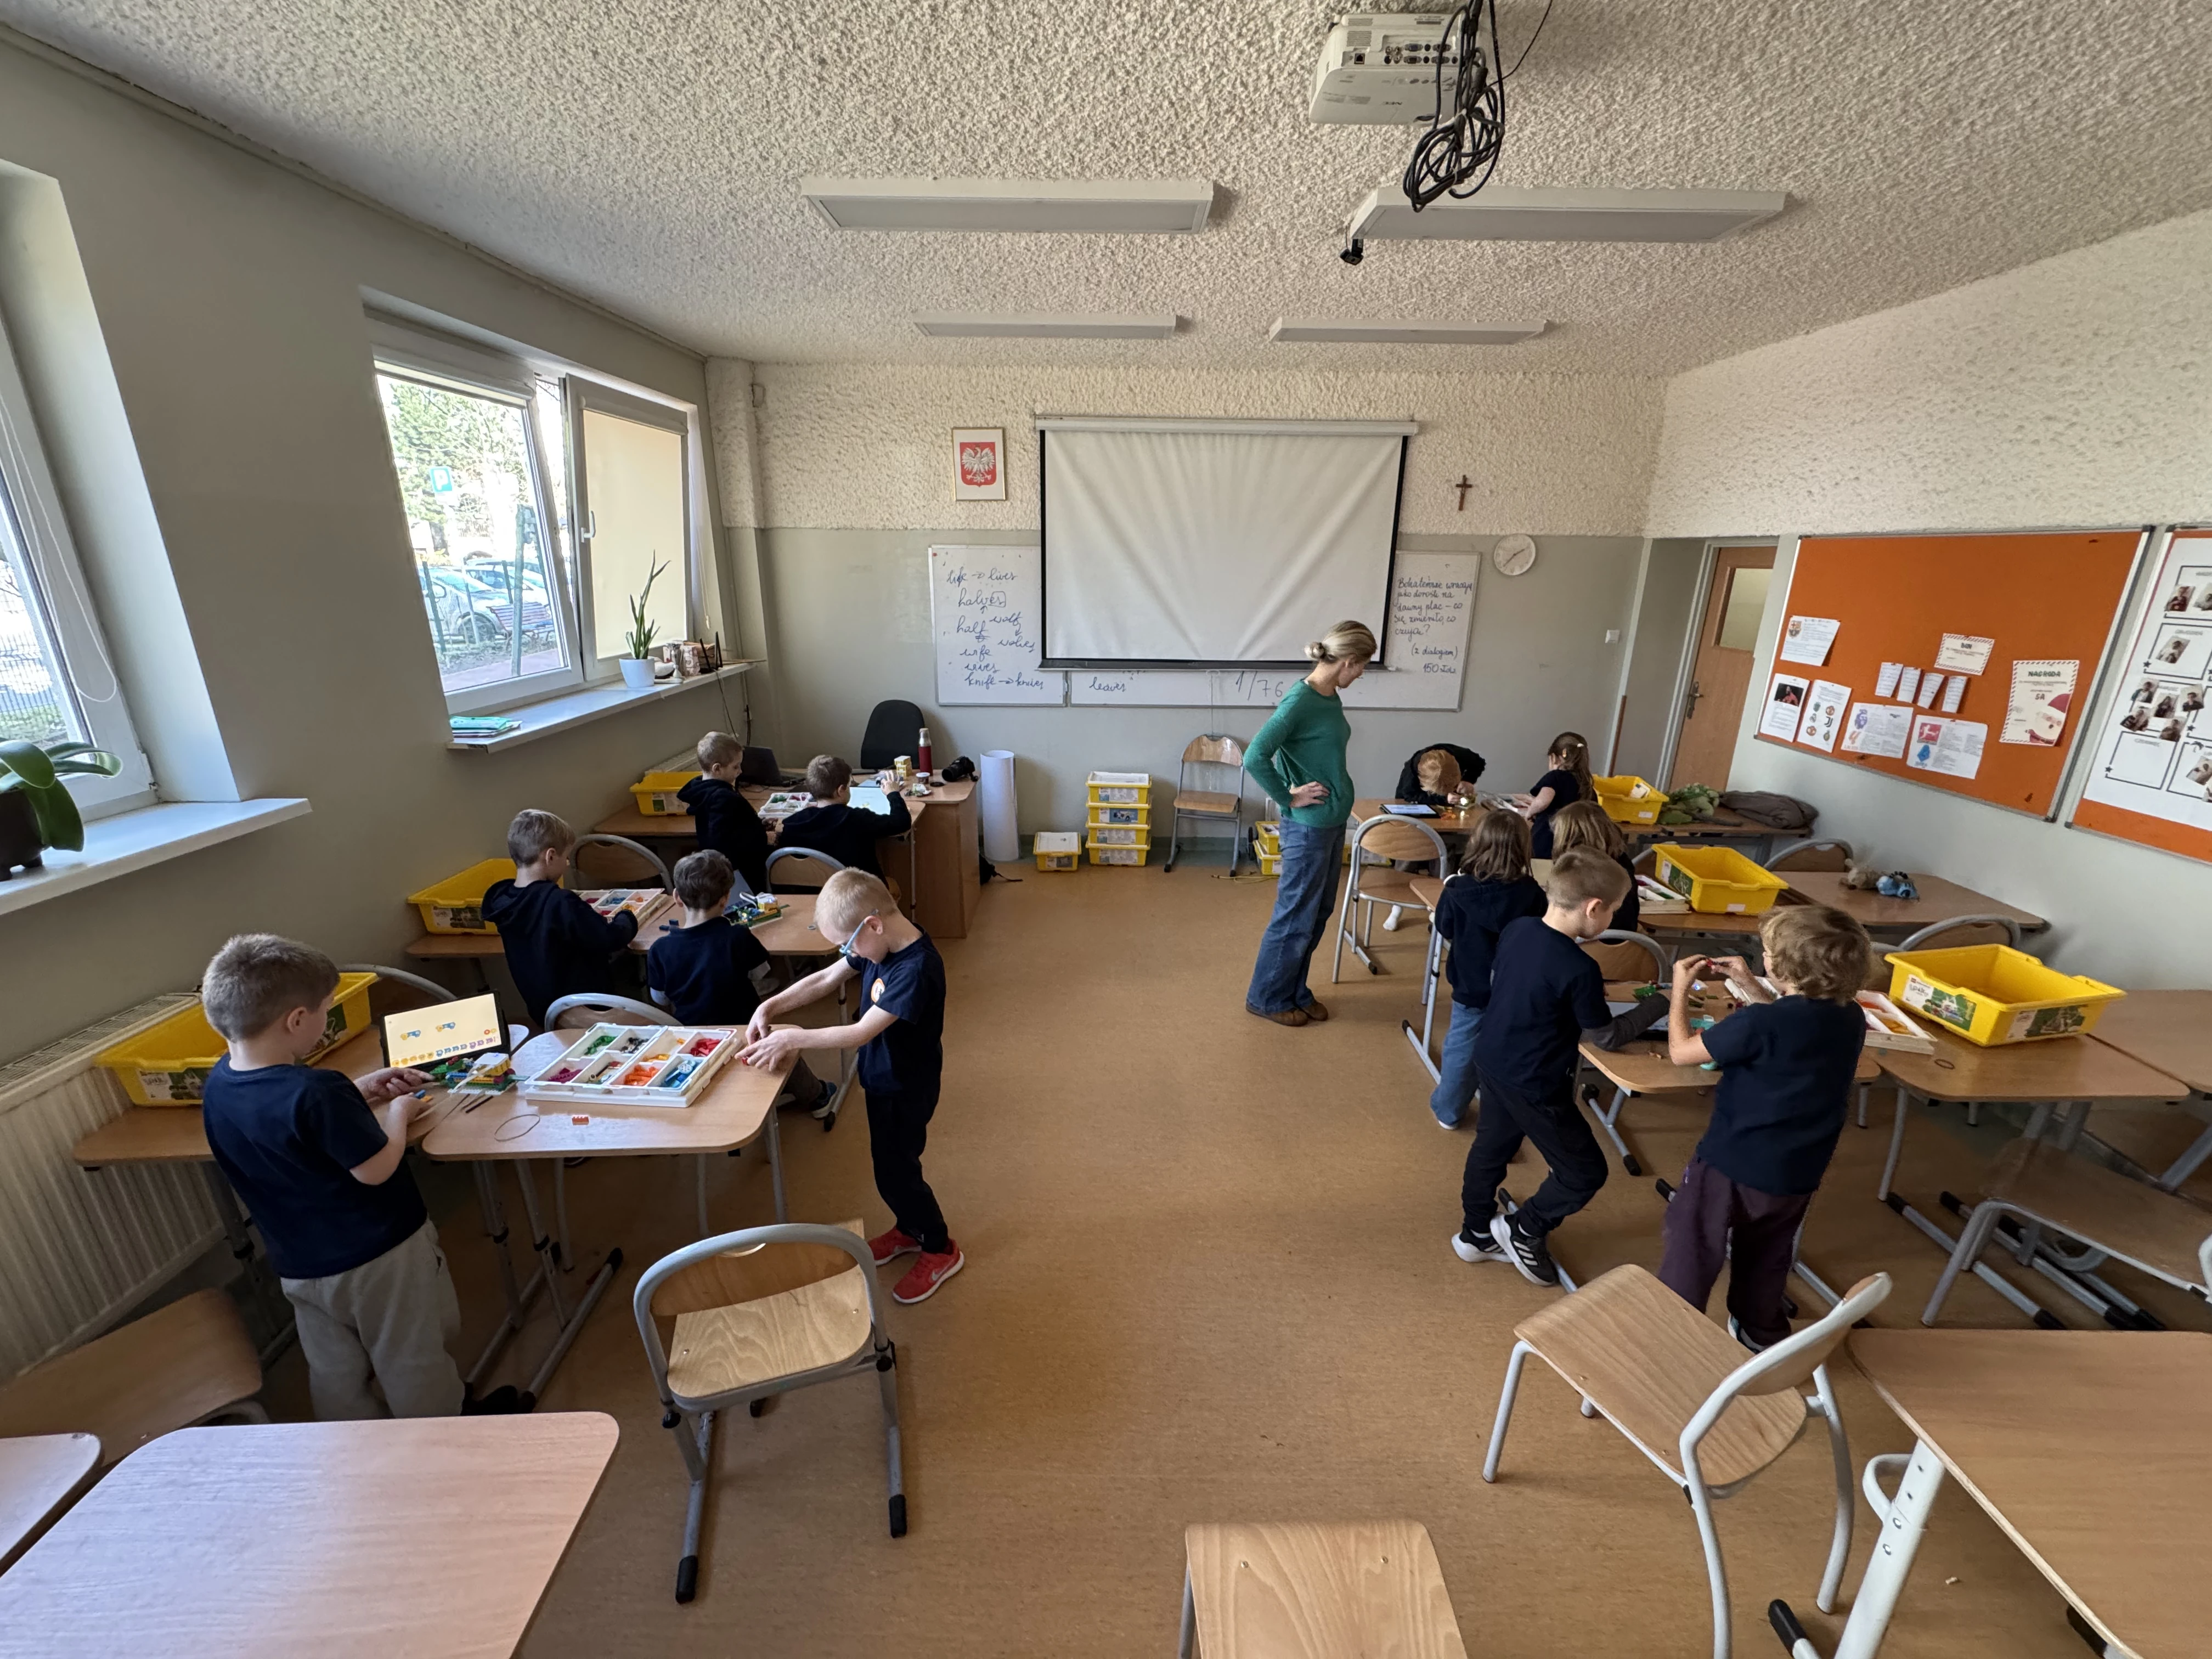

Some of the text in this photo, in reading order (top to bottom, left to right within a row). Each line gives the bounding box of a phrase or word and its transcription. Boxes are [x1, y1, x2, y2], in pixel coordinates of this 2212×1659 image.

[433, 469, 449, 490] P
[1425, 600, 1443, 616] plac
[1423, 663, 1439, 673] 150
